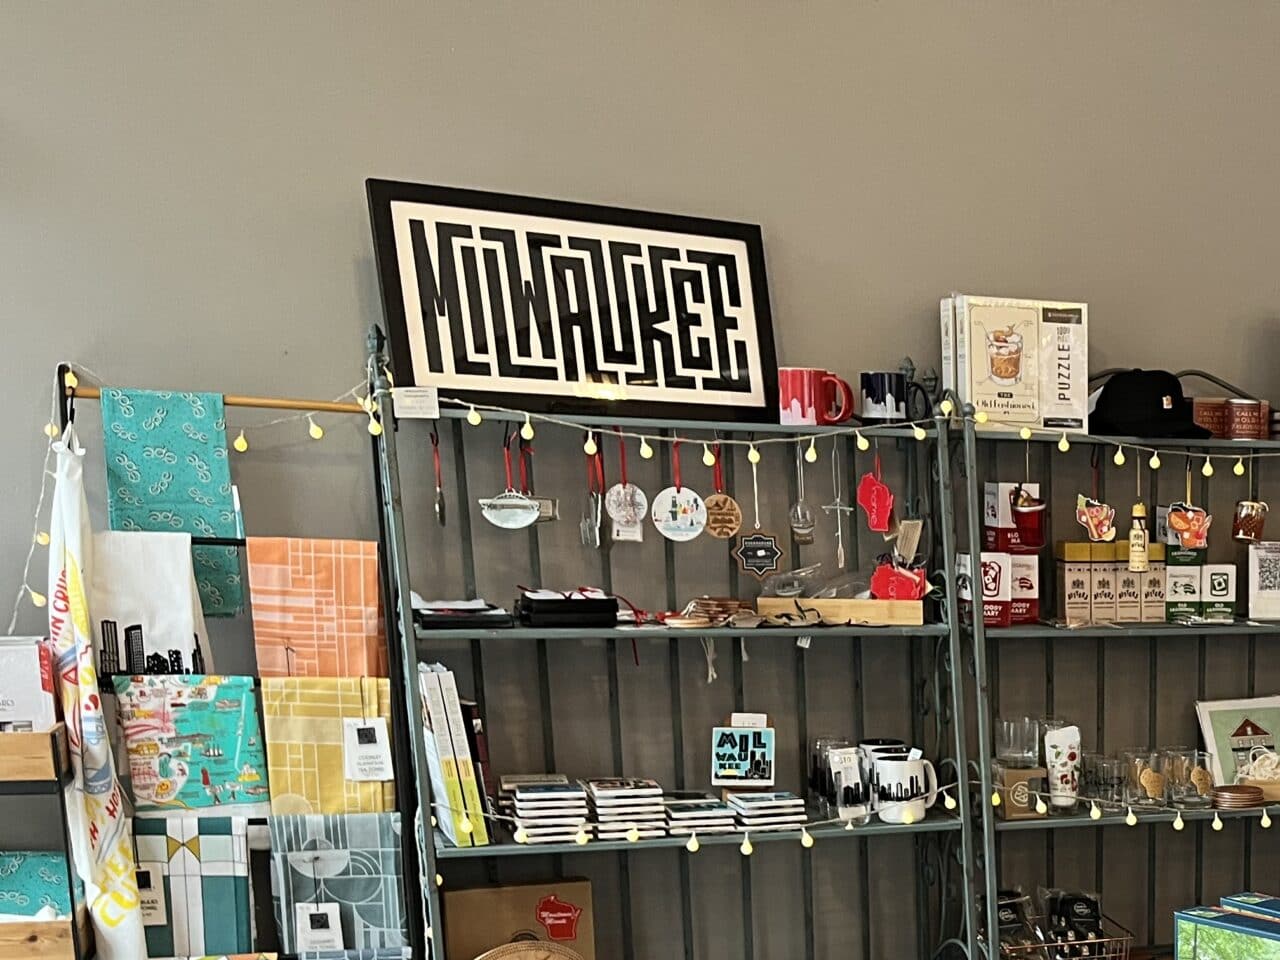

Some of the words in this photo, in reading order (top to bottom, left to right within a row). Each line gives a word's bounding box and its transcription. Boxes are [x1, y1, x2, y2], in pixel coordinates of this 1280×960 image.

[1057, 344, 1071, 401] PUZZLE
[717, 731, 766, 753] MIL
[715, 752, 749, 761] WAU
